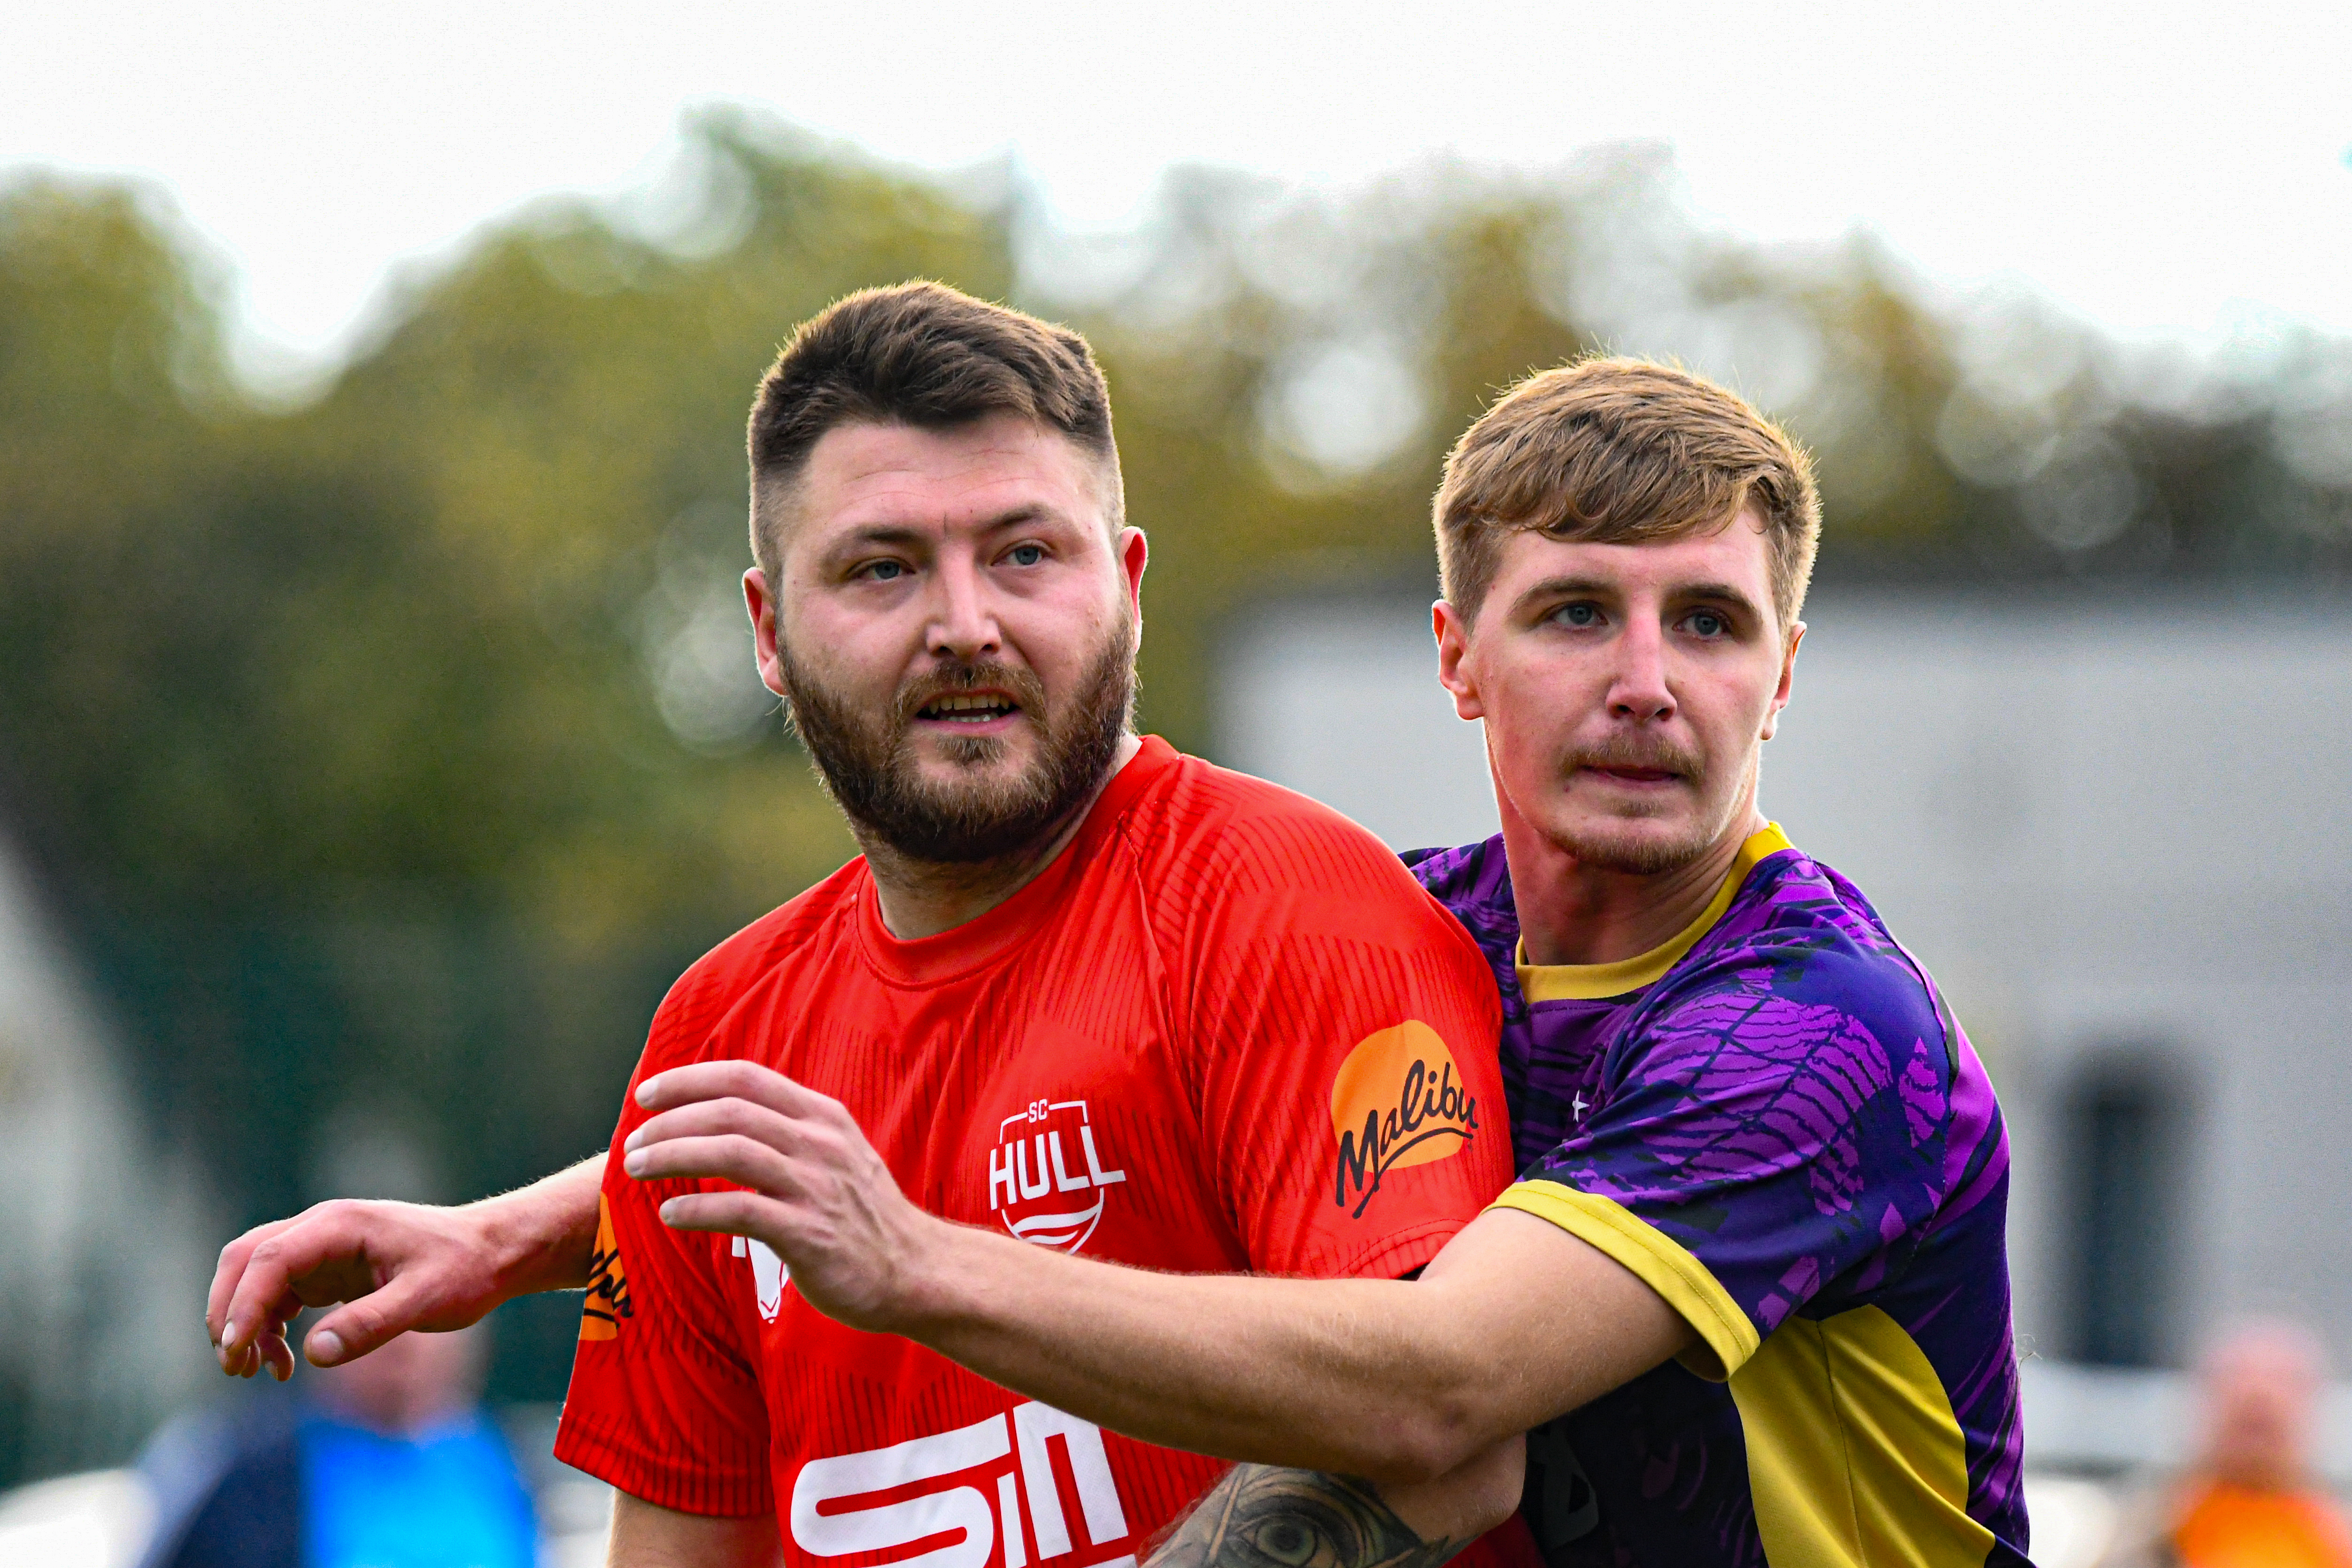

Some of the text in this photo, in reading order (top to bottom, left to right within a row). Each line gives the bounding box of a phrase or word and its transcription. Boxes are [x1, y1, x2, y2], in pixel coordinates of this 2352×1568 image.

[1028, 1098, 1048, 1123] SC
[1335, 1059, 1479, 1207] Malibu
[989, 1126, 1126, 1211] HULL
